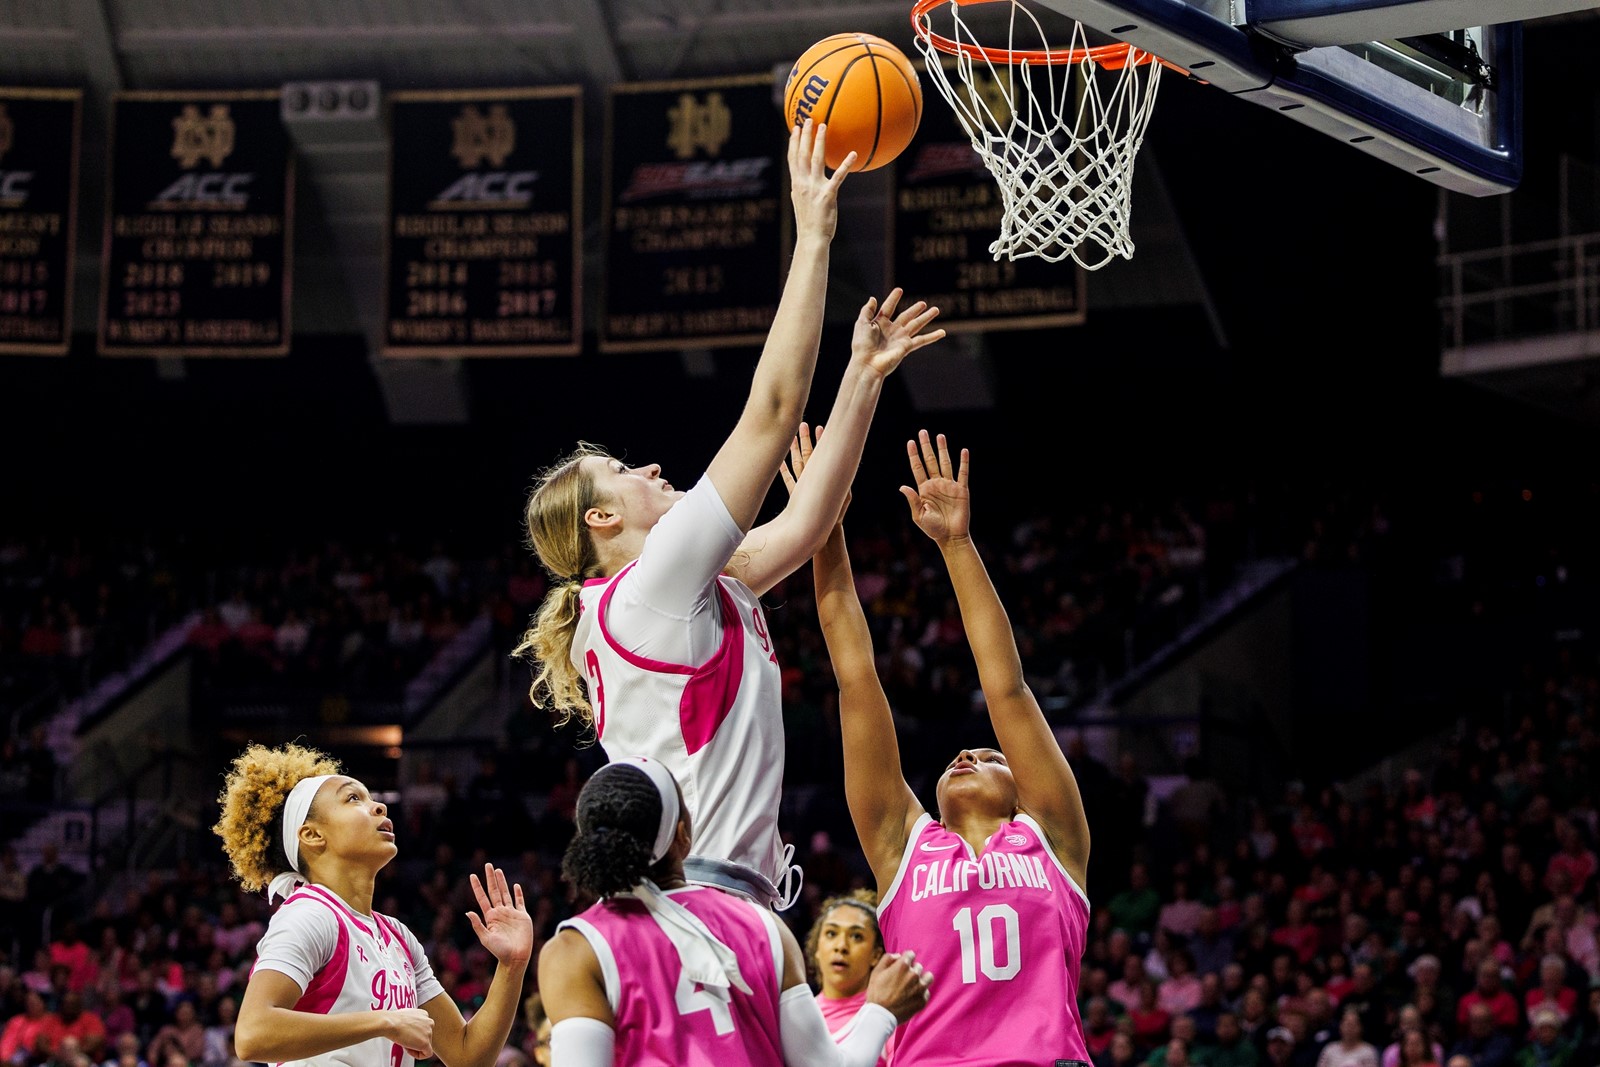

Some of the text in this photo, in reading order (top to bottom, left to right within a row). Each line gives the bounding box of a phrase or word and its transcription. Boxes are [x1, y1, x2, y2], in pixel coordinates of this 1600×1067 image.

[149, 172, 256, 206] ACC
[432, 170, 540, 206] ACC
[911, 851, 1052, 902] CALIFORNIA
[953, 903, 1021, 984] 10
[674, 965, 735, 1036] 4
